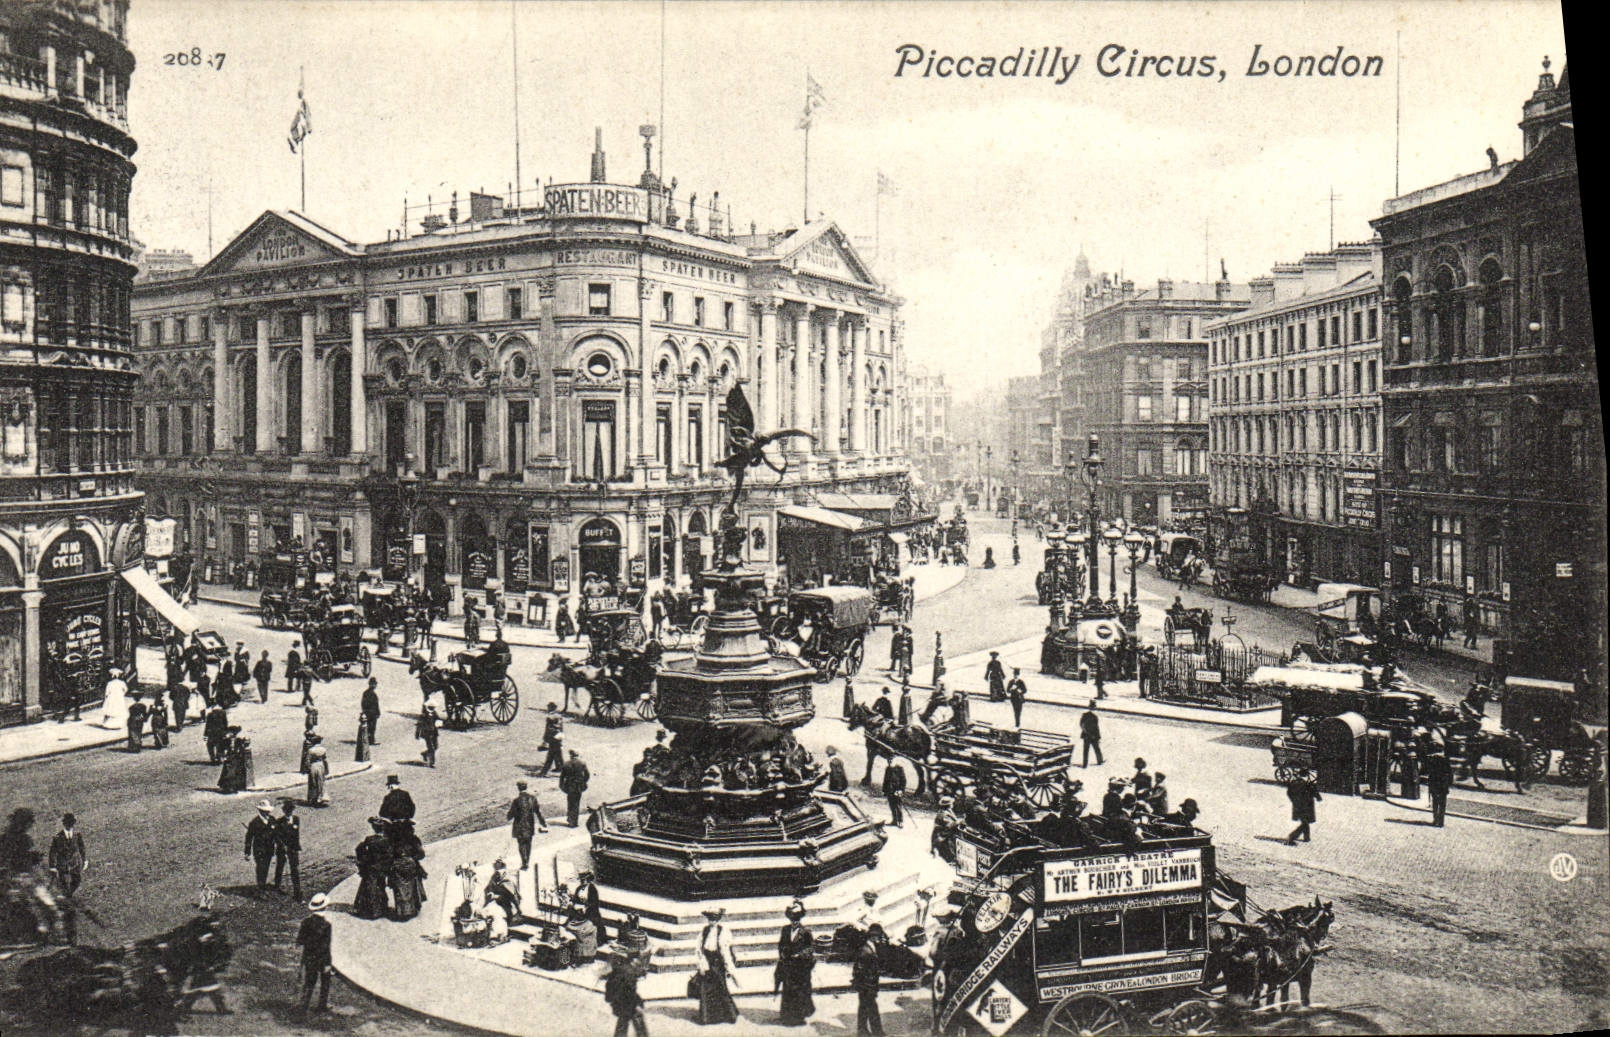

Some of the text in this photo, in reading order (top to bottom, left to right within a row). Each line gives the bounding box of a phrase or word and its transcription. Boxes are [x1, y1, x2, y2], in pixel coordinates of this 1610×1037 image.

[262, 235, 299, 251] LONDON
[256, 245, 306, 262] PAVILION
[557, 250, 638, 265] RESTAURANT
[465, 257, 506, 273] BEER
[662, 260, 735, 284] SPATEN BEER
[52, 553, 84, 569] CYCLES
[1073, 850, 1175, 868] GARRICK THEATRE
[1053, 864, 1197, 894] THE FAIRY'S DILEMMA
[954, 970, 985, 1003] BRIDGE
[982, 917, 1029, 971] RAILWAYS
[1171, 970, 1201, 982] BRIDGE
